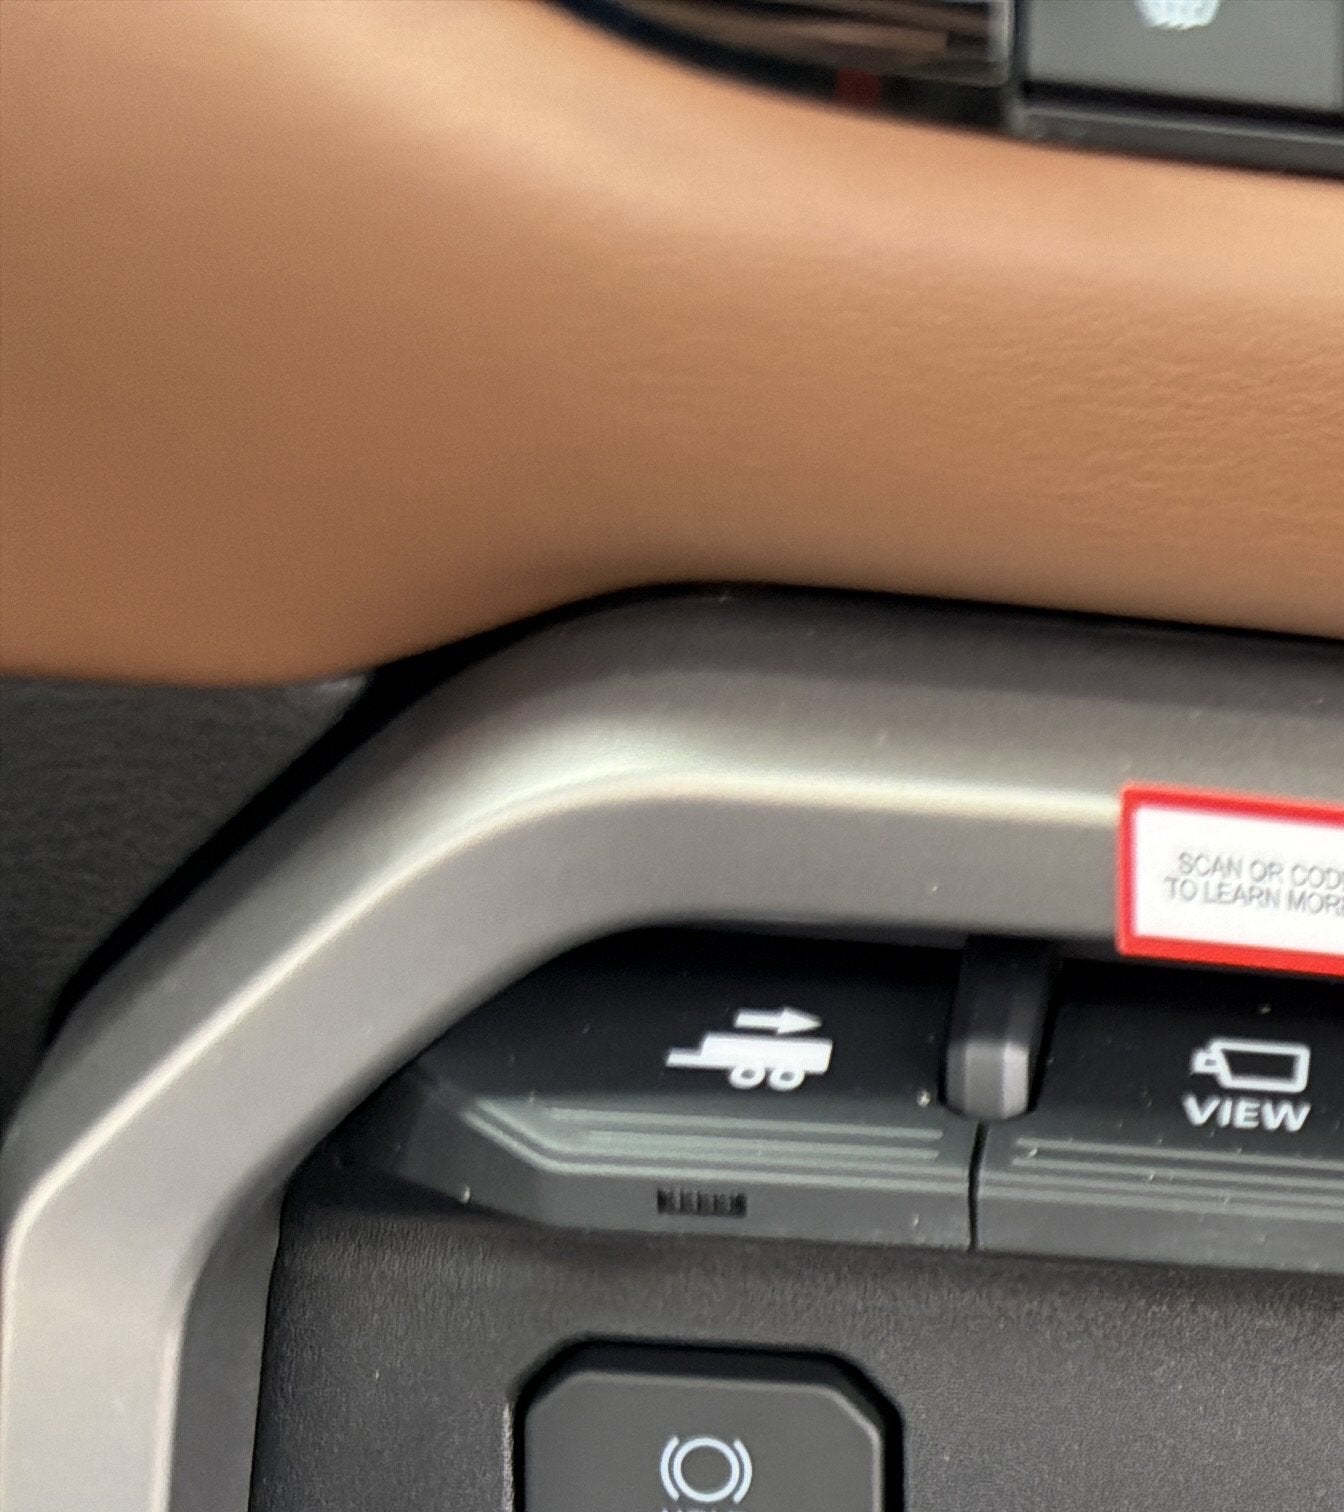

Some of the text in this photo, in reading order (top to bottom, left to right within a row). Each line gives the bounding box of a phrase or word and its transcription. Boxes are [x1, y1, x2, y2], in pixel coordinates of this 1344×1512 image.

[1178, 851, 1243, 880] SCAN
[1163, 876, 1198, 902] TO
[1202, 881, 1281, 909] LEARN
[1183, 1092, 1313, 1133] VIEW
